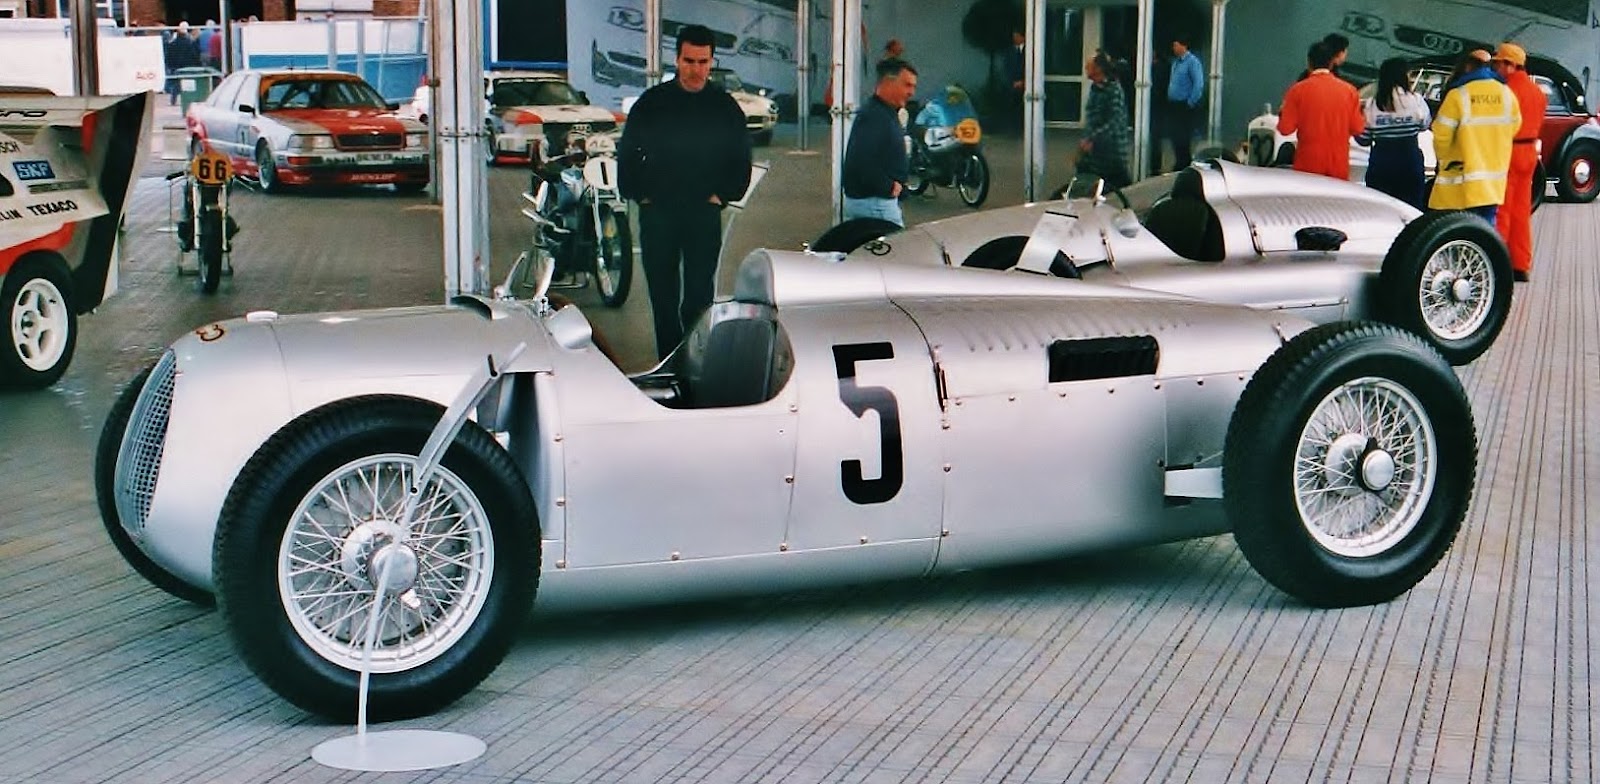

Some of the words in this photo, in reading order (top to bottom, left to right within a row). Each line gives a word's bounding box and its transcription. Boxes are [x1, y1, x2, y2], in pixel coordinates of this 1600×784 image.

[16, 162, 50, 179] SKF
[198, 158, 227, 180] 66
[600, 161, 609, 186] 1
[26, 199, 79, 216] TEXACO
[831, 341, 904, 505] 5
